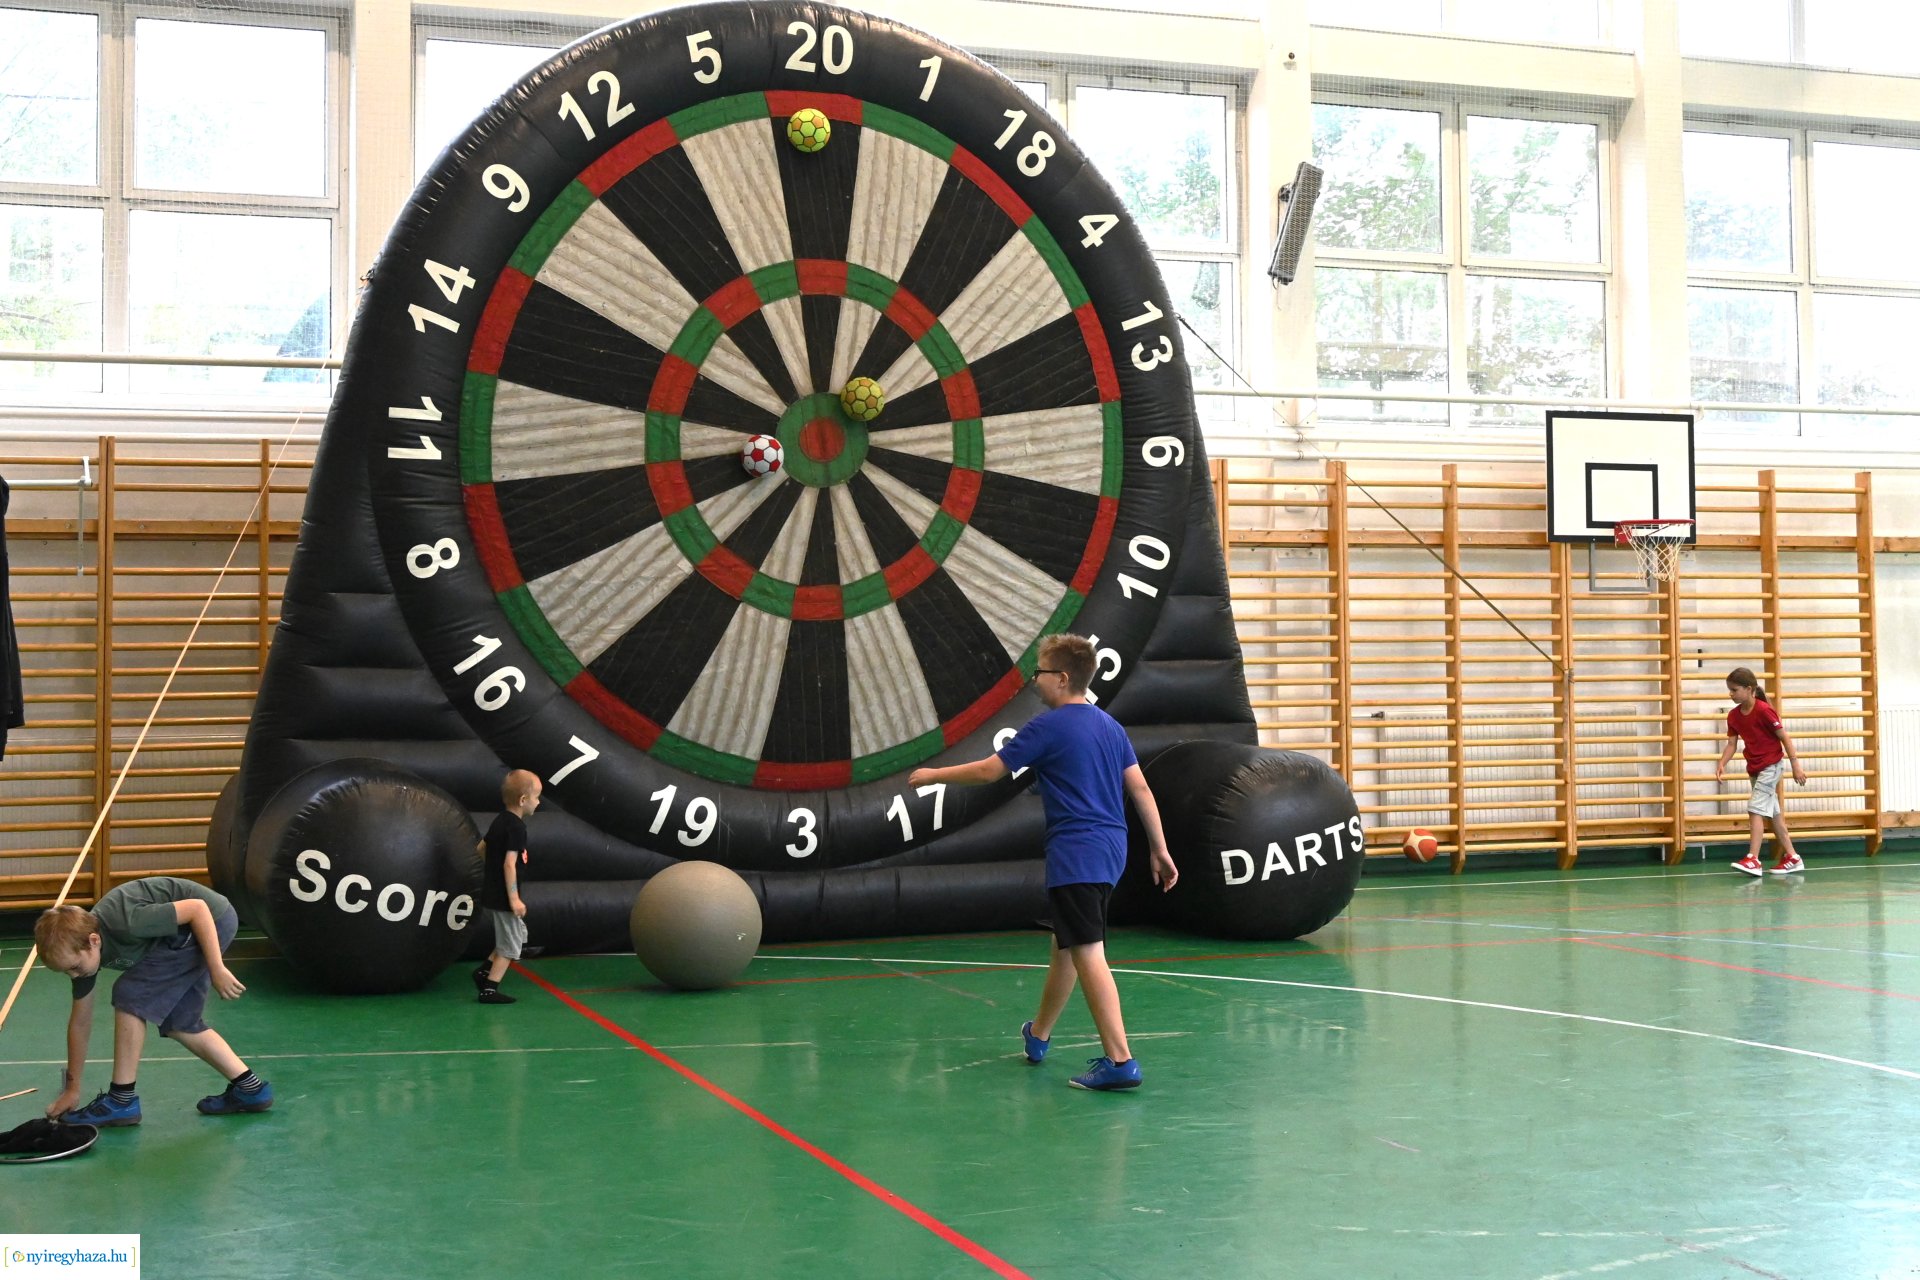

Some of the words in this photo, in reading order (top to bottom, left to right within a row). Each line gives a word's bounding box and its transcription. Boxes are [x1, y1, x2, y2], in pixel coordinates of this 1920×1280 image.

[685, 30, 723, 85] 5
[784, 20, 854, 76] 20
[917, 55, 943, 102] 1
[556, 70, 637, 142] 12
[993, 107, 1057, 178] 18
[481, 163, 532, 213] 9
[1078, 213, 1121, 249] 4
[406, 258, 477, 335] 14
[1121, 299, 1174, 372] 13
[387, 395, 443, 461] 11
[1141, 435, 1186, 469] 6
[406, 536, 460, 580] 8
[1116, 534, 1172, 601] 10
[452, 633, 526, 712] 16
[548, 733, 600, 787] 7
[648, 783, 719, 848] 19
[785, 807, 819, 858] 3
[885, 782, 948, 842] 17
[1219, 813, 1365, 886] DARTS
[289, 849, 474, 931] Score
